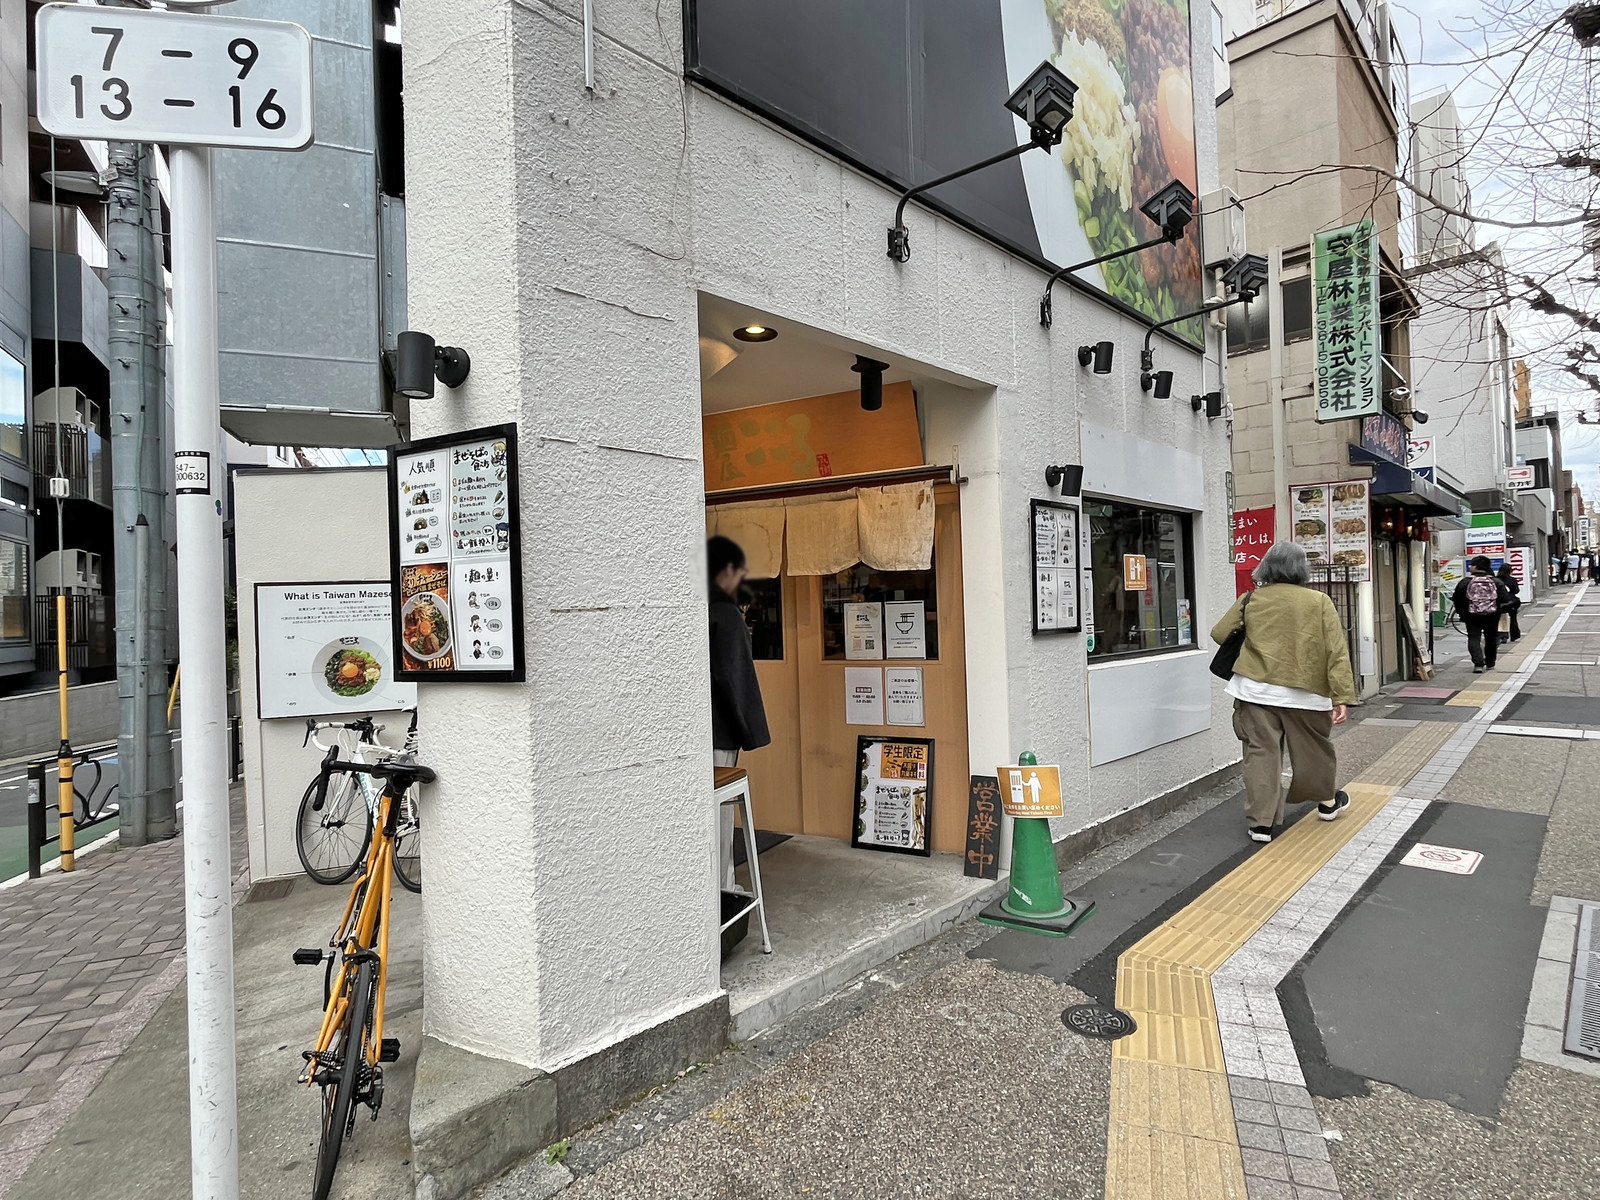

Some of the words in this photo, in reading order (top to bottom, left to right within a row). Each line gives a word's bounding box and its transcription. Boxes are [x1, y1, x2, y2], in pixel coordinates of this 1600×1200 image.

[91, 27, 124, 72] 7
[227, 38, 259, 80] 9
[70, 75, 132, 121] 13
[228, 85, 286, 130] 16
[1326, 235, 1357, 412] 守屋林業株式会社
[408, 459, 436, 476] 人気順
[1510, 550, 1524, 586] KIRIN
[284, 592, 309, 600] What
[312, 592, 321, 600] is
[323, 591, 356, 599] Taiwan
[427, 657, 451, 669] ¥1100
[883, 744, 924, 760] 学生限定
[967, 781, 999, 878] 営業中
